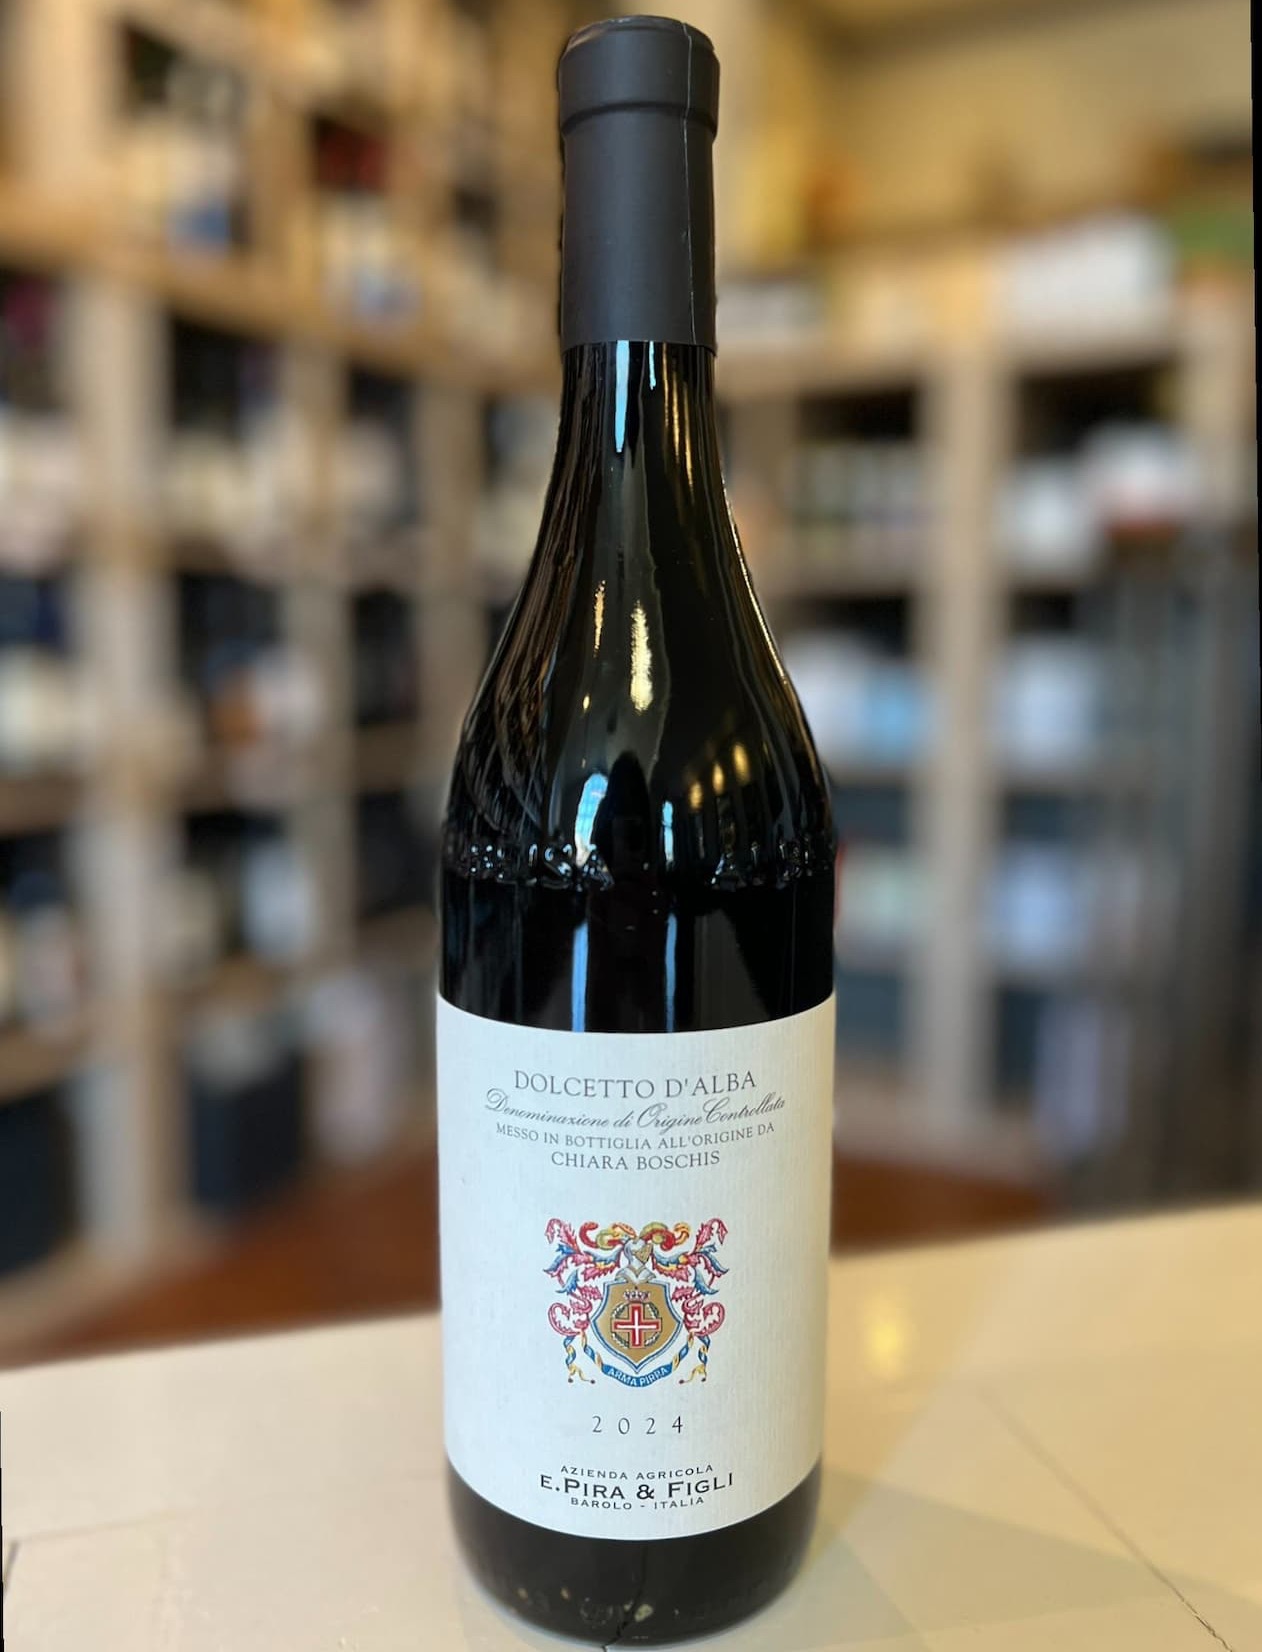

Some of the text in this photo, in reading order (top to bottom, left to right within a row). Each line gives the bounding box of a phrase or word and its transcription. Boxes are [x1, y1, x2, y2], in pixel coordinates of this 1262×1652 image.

[514, 1069, 756, 1099] DOLCETTO D'ALBA
[484, 1087, 786, 1135] Denominazione di Origine Controllata
[496, 1122, 775, 1150] MESSO IN BOTTIGLIA ALL'ORIGINE DA
[551, 1150, 720, 1171] CHIARA BOSCHIS
[607, 1367, 638, 1387] ARMA
[560, 1464, 714, 1480] AZIENDA AGRICOLA
[636, 1484, 655, 1500] &
[571, 1497, 632, 1510] BAROLO
[654, 1496, 705, 1510] ITALIA
